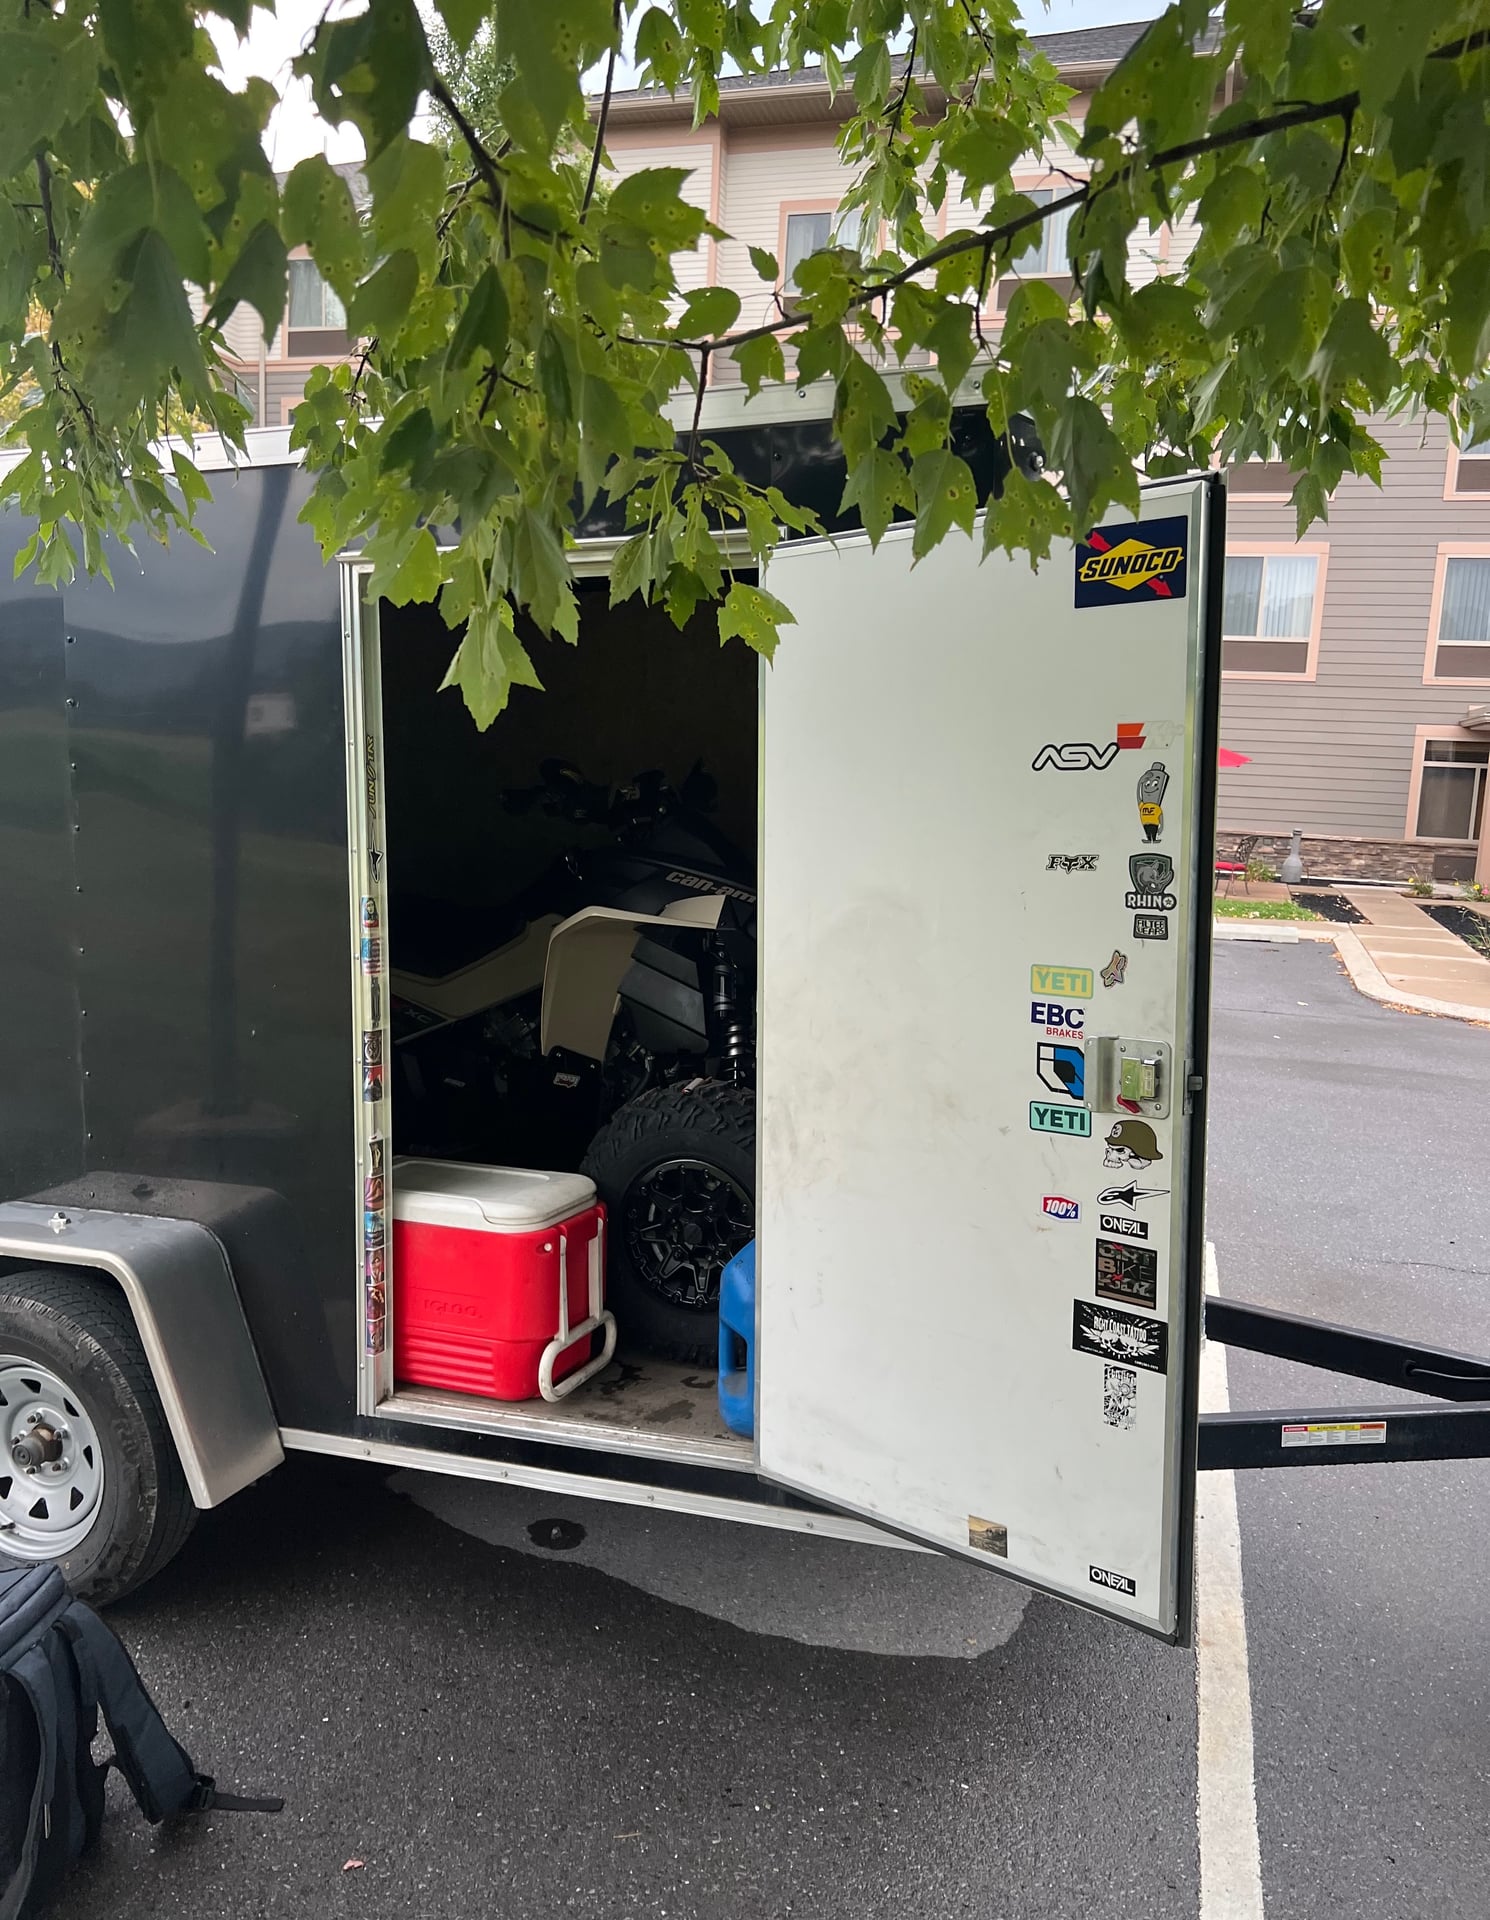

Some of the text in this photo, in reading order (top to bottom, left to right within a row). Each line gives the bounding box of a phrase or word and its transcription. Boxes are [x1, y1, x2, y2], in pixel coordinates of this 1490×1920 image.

[1083, 548, 1181, 580] SUNOCO
[1031, 741, 1121, 772] ASV
[1126, 893, 1176, 910] RHINO
[1035, 971, 1088, 993] YETI
[1031, 1001, 1085, 1029] EBC
[1045, 1026, 1084, 1040] BRAKES
[1034, 1107, 1086, 1131] YETI
[1045, 1199, 1077, 1218] 100%
[1109, 1319, 1126, 1336] COAST
[1126, 1324, 1148, 1343] TATTOO
